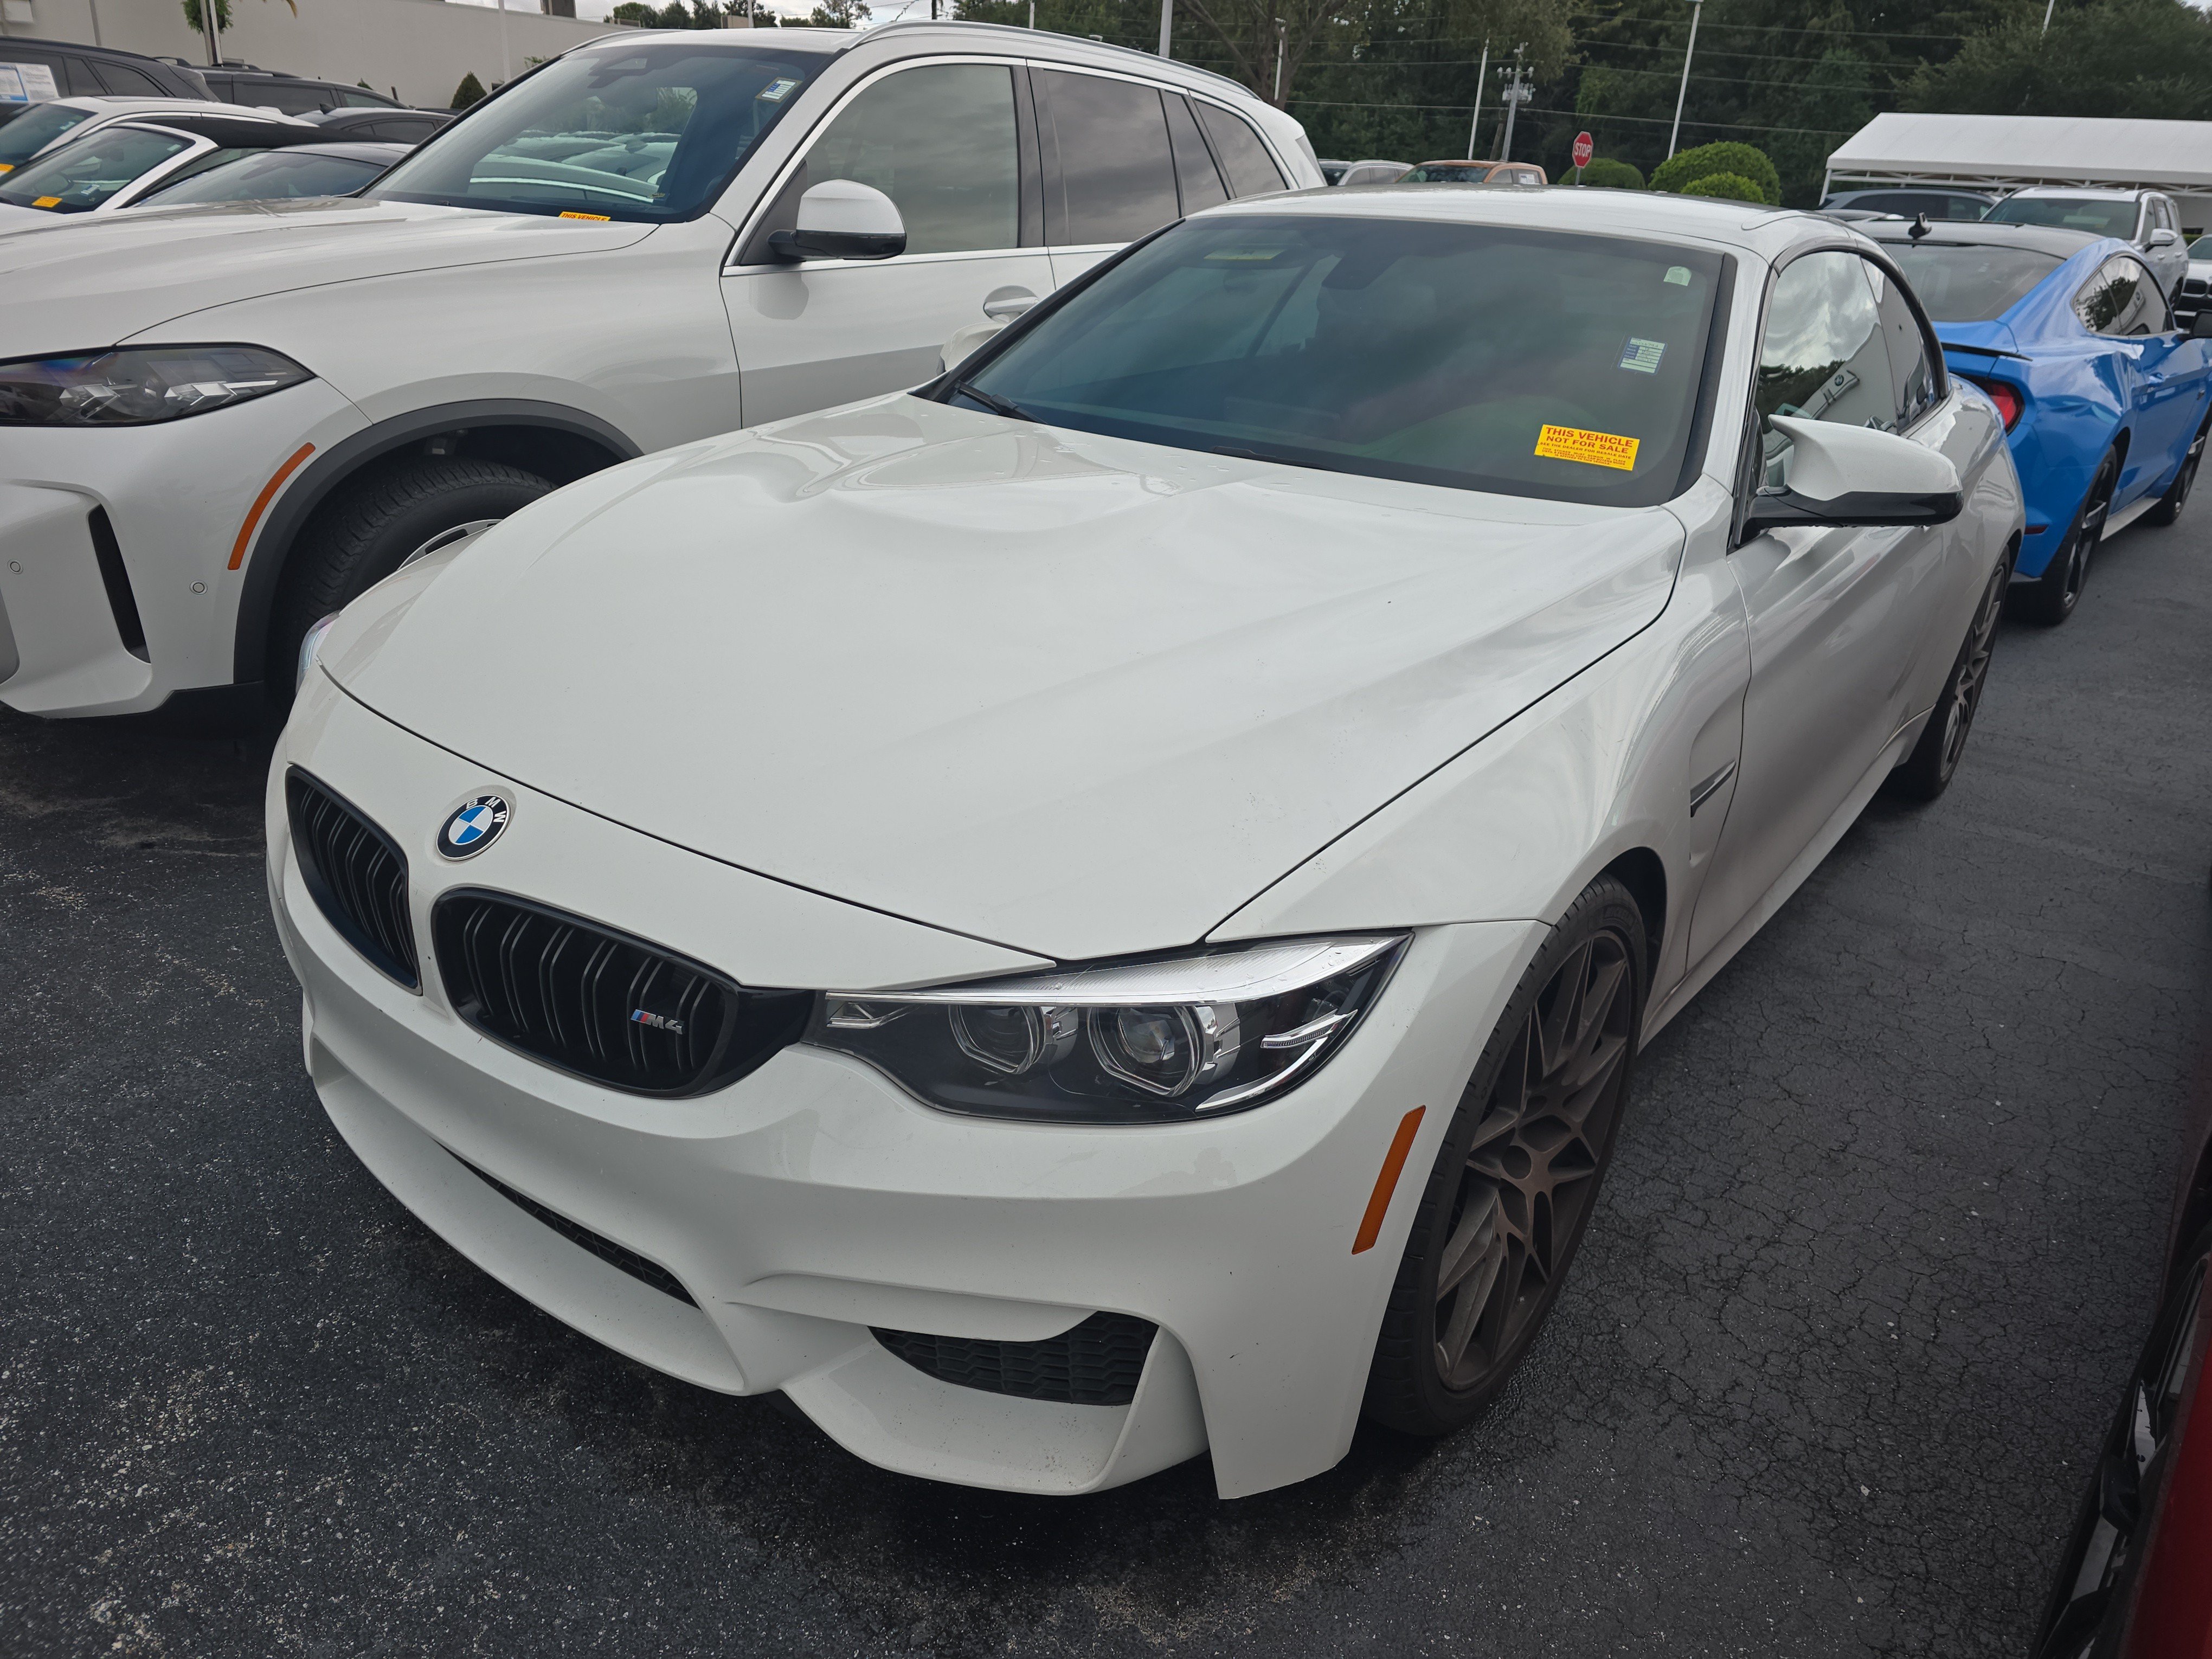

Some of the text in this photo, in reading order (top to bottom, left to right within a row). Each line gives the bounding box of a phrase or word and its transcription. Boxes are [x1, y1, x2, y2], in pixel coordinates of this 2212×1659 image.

[1574, 142, 1591, 157] STOP
[1546, 427, 1634, 447] THIS VEHICLE
[1572, 439, 1595, 448] FOR
[1599, 443, 1629, 454] SALE
[466, 797, 506, 822] BMW
[644, 1013, 683, 1035] M4
